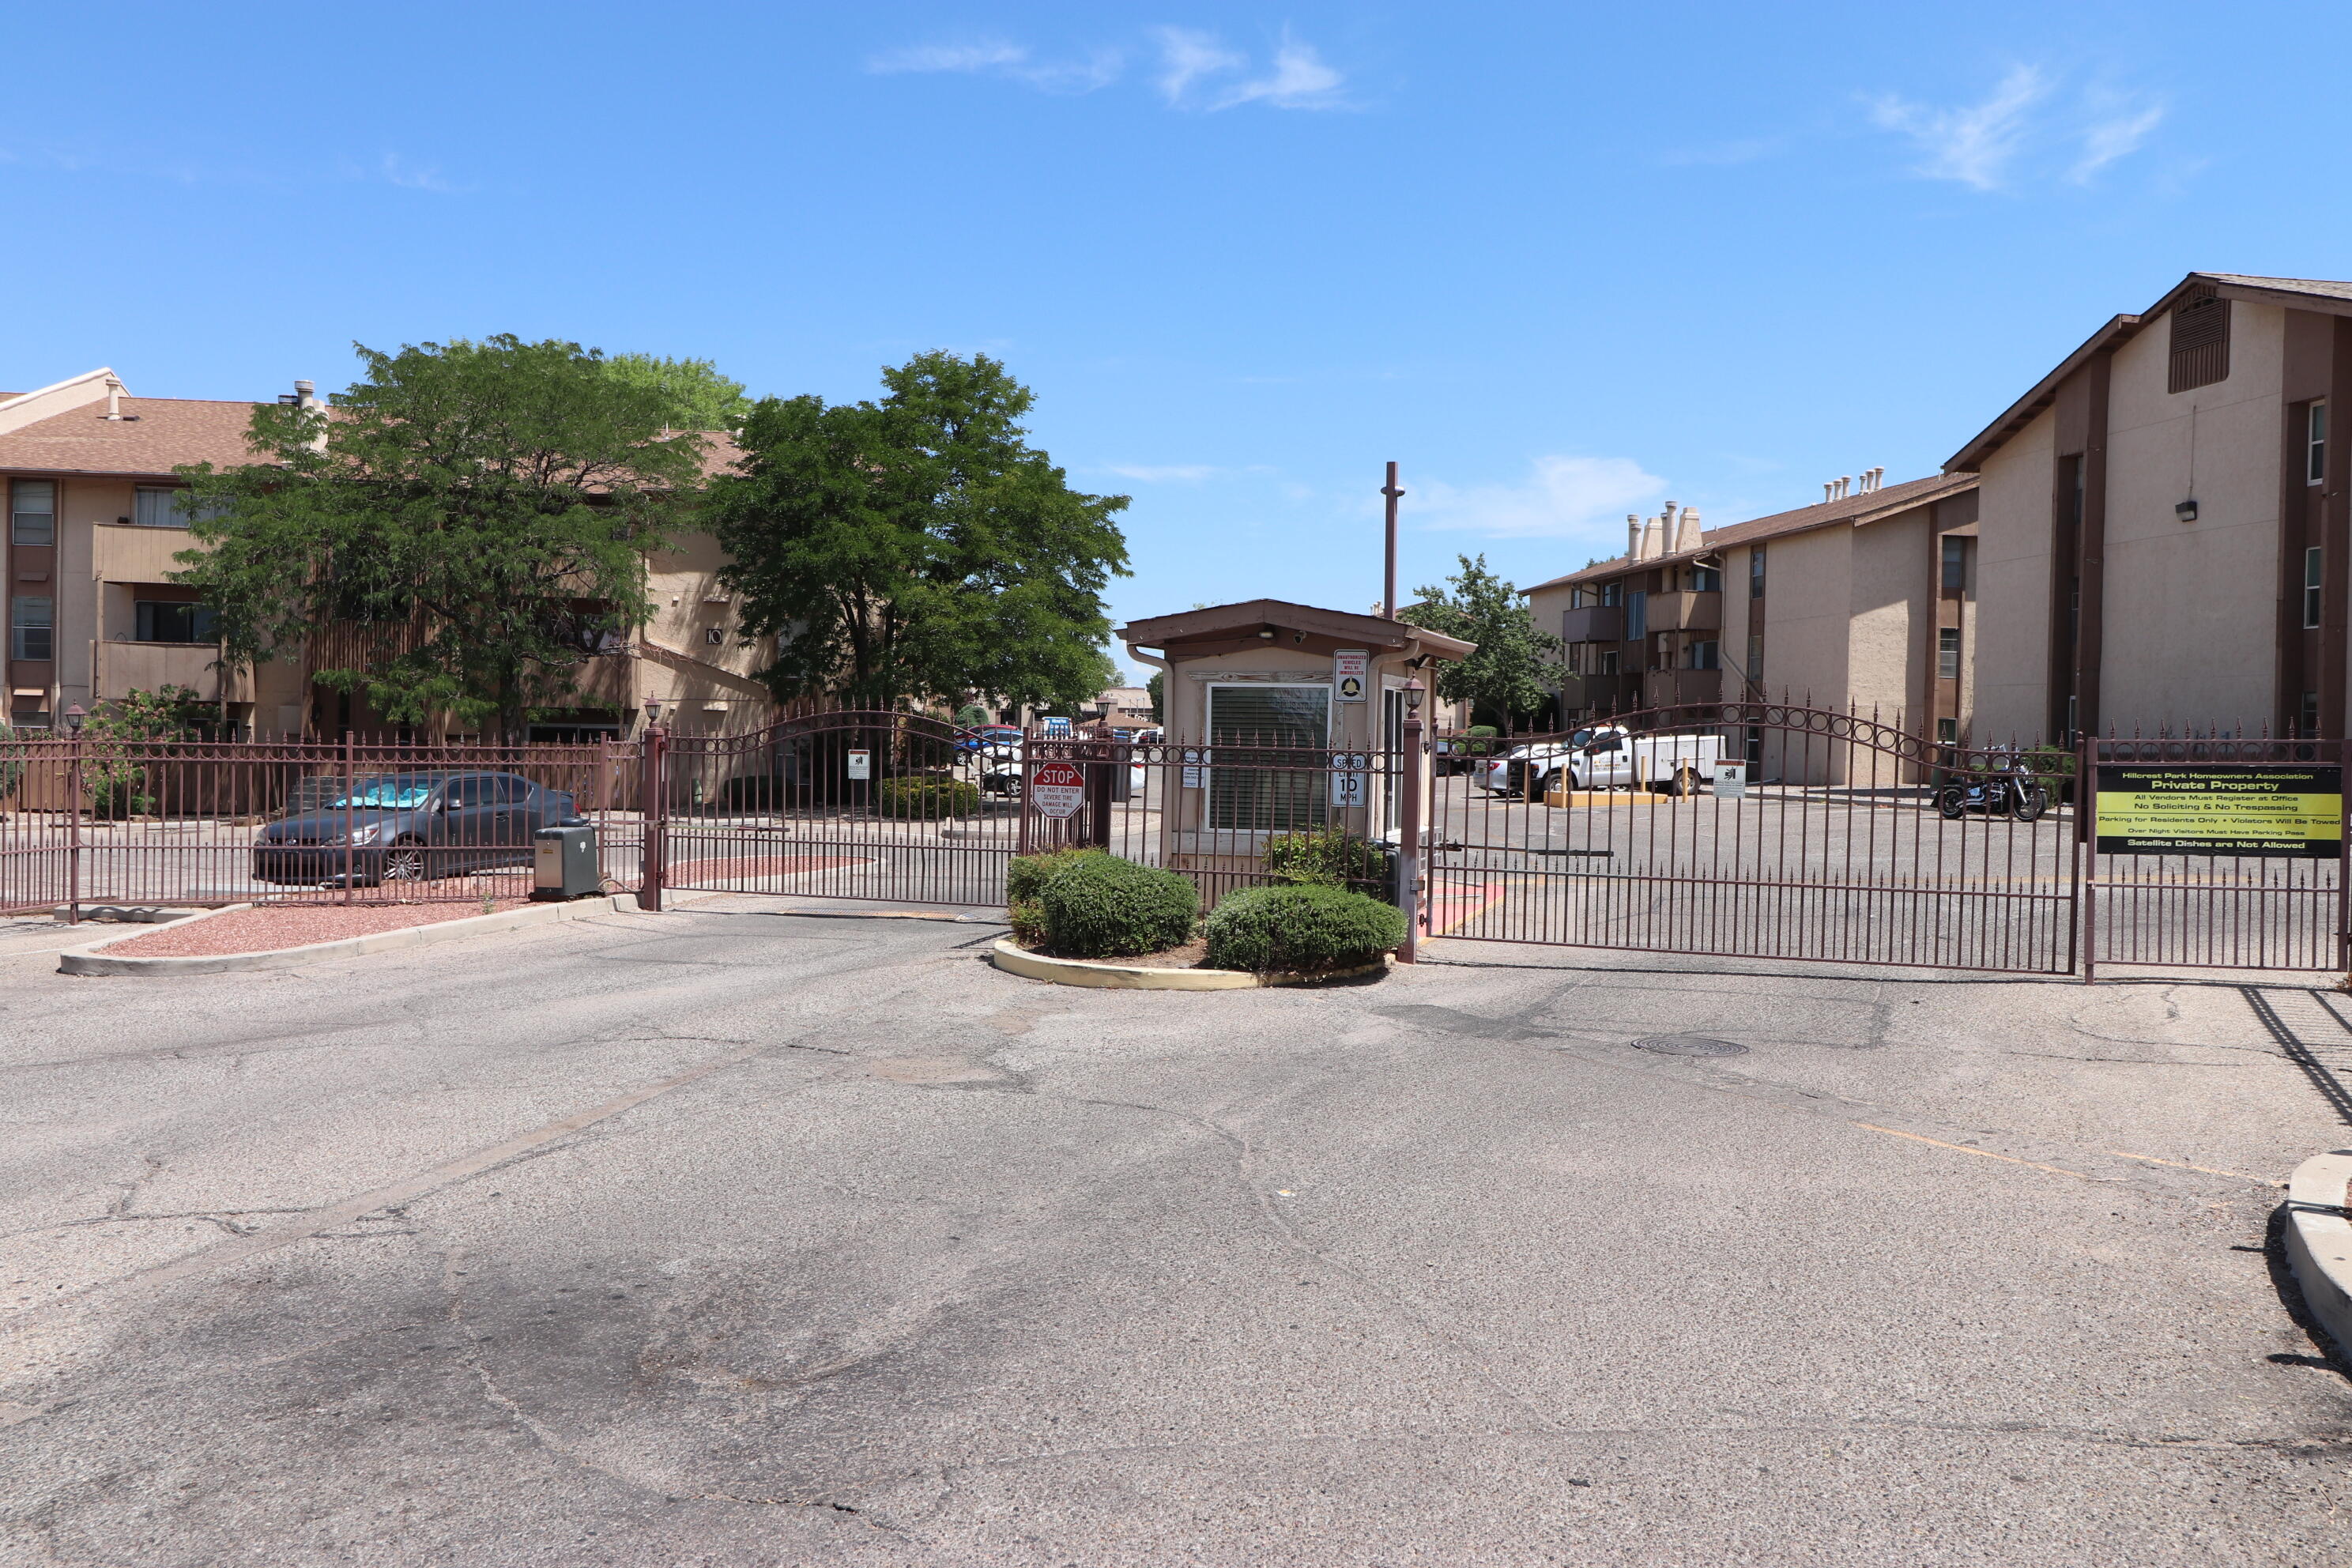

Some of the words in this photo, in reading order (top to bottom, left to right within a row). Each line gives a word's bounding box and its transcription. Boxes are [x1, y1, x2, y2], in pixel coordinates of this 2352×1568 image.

[707, 630, 722, 643] 10
[1336, 759, 1362, 768] SPED
[1043, 770, 1075, 784] STOP
[1340, 778, 1358, 792] 10
[2151, 780, 2206, 790] Private
[2211, 781, 2279, 791] Property
[2233, 804, 2298, 812] Trespassing
[2127, 839, 2172, 847] Satellite
